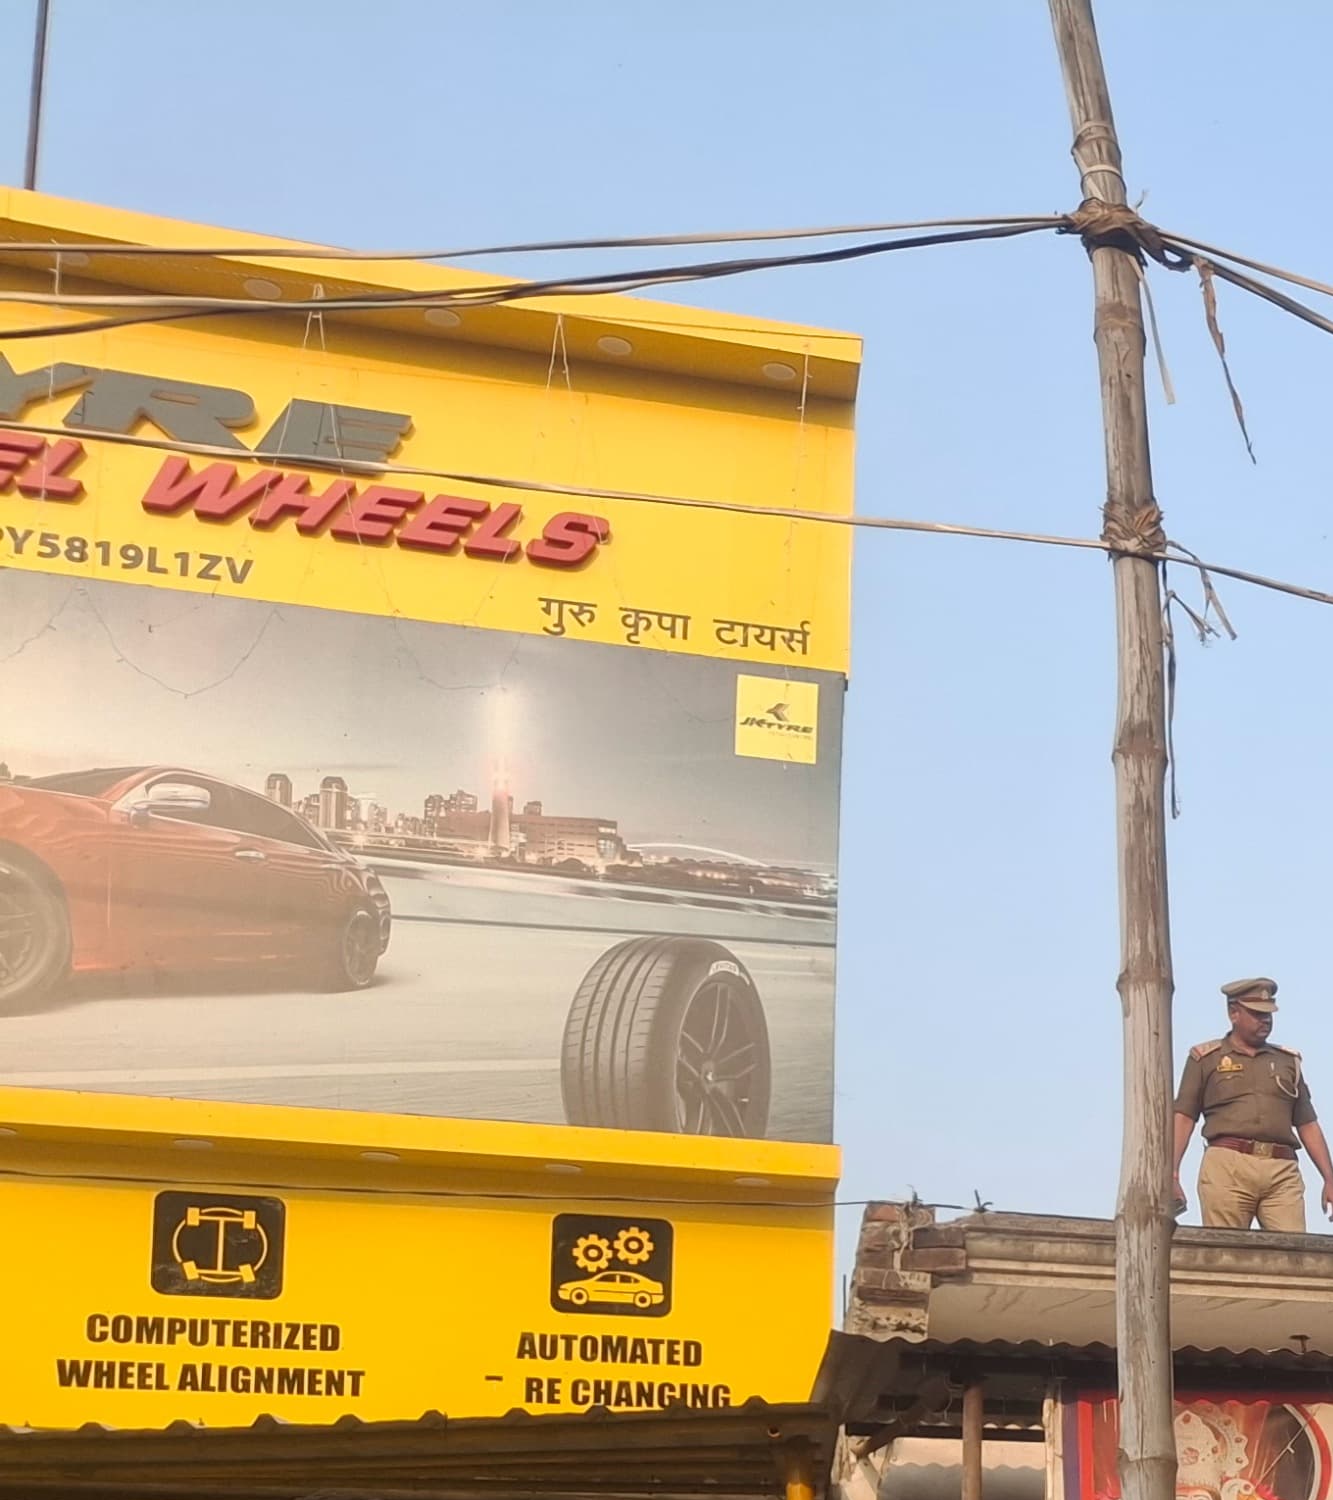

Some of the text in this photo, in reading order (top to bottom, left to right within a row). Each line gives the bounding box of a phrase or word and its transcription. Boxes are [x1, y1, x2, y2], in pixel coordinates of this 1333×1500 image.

[141, 455, 611, 571] WHEELS
[0, 526, 254, 585] Y5819L1ZV
[538, 597, 810, 655] गुरु कृपा टायर्स
[86, 1313, 342, 1353] COMPUTERIZED
[516, 1332, 702, 1367] AUTOMATED
[56, 1359, 366, 1398] WHEEL ALIGNMENT
[570, 1378, 731, 1409] CHANGING
